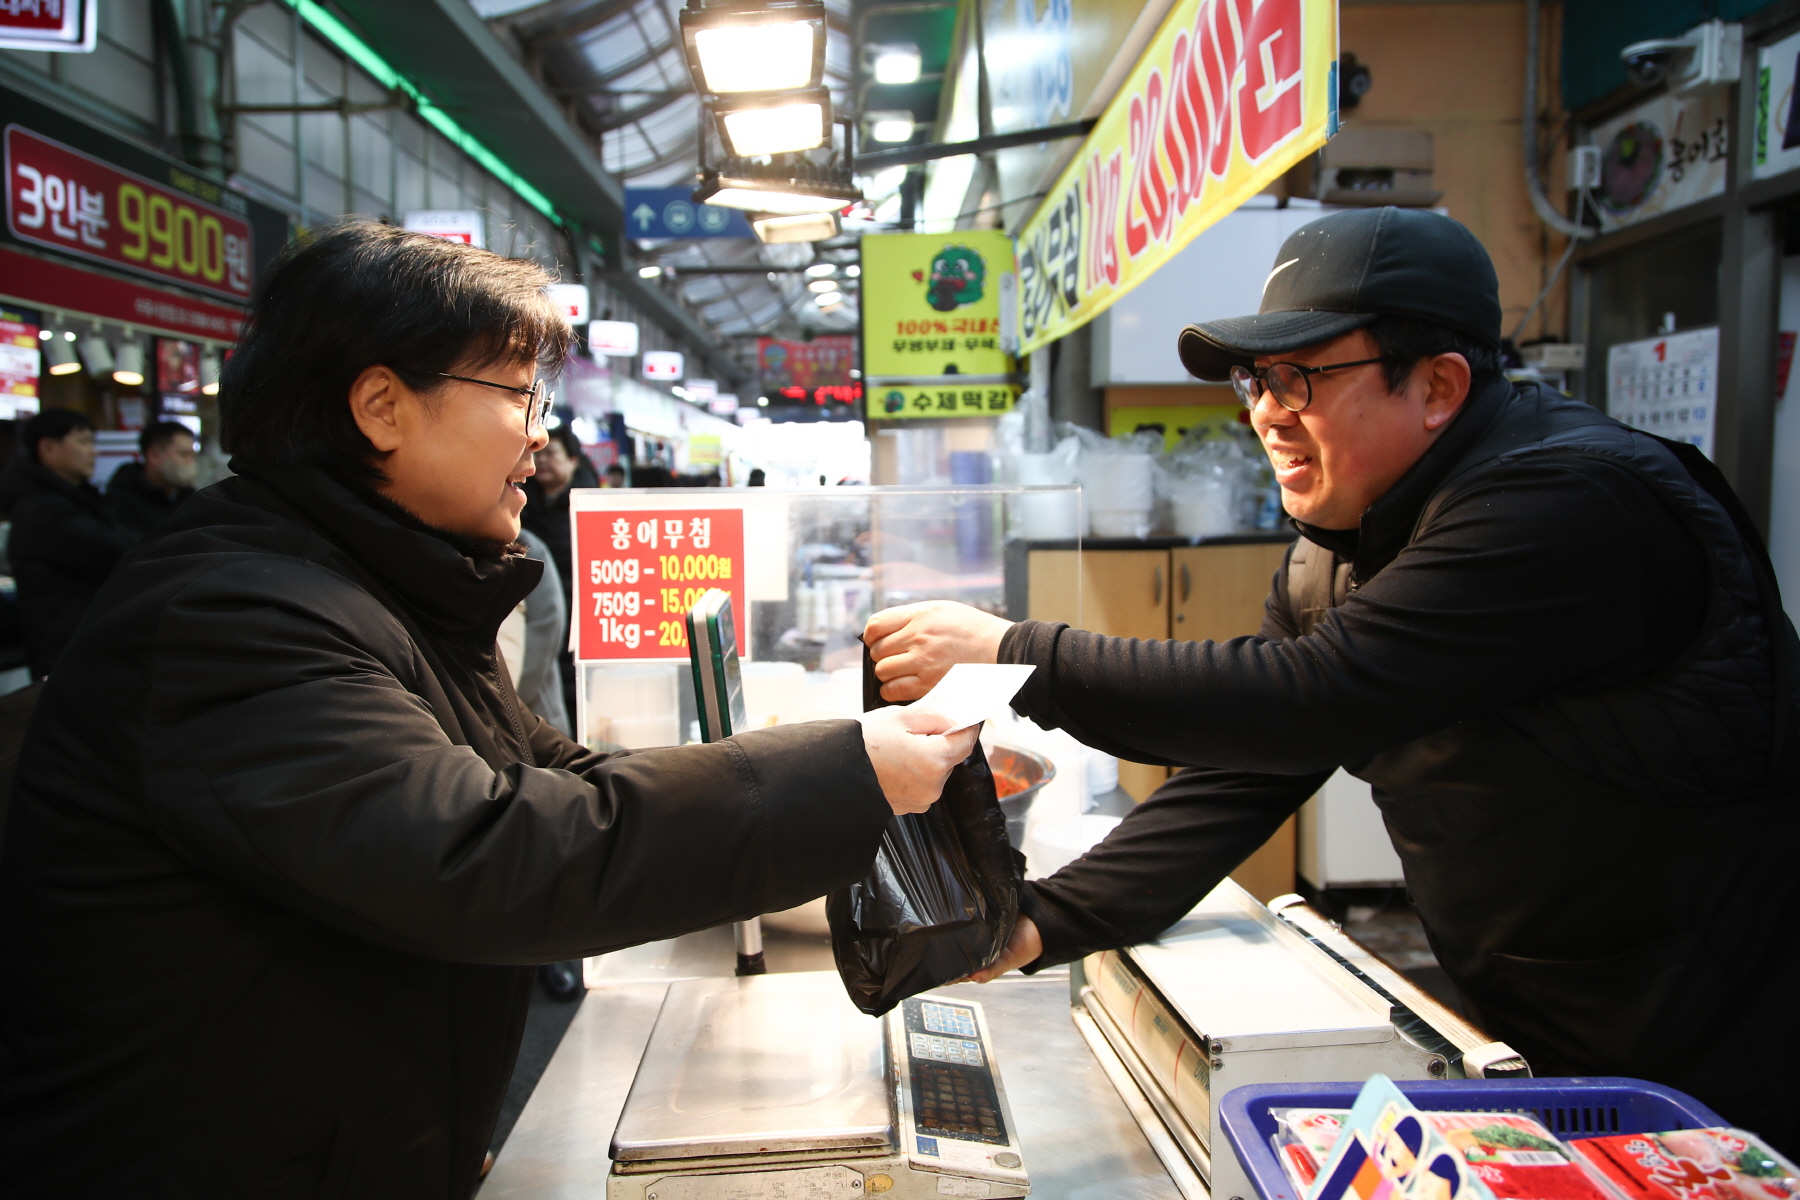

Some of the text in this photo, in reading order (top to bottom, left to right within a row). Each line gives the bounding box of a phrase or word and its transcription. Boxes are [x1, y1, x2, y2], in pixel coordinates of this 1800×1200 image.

[17, 163, 249, 292] 3인분 9900원
[1086, 148, 1122, 293] 1kg
[1653, 341, 1667, 362] 1
[610, 517, 711, 550] 홍어무침
[590, 558, 640, 584] 500g
[659, 554, 732, 582] 10,000원
[592, 591, 640, 616] 750g
[599, 617, 640, 649] 1kg
